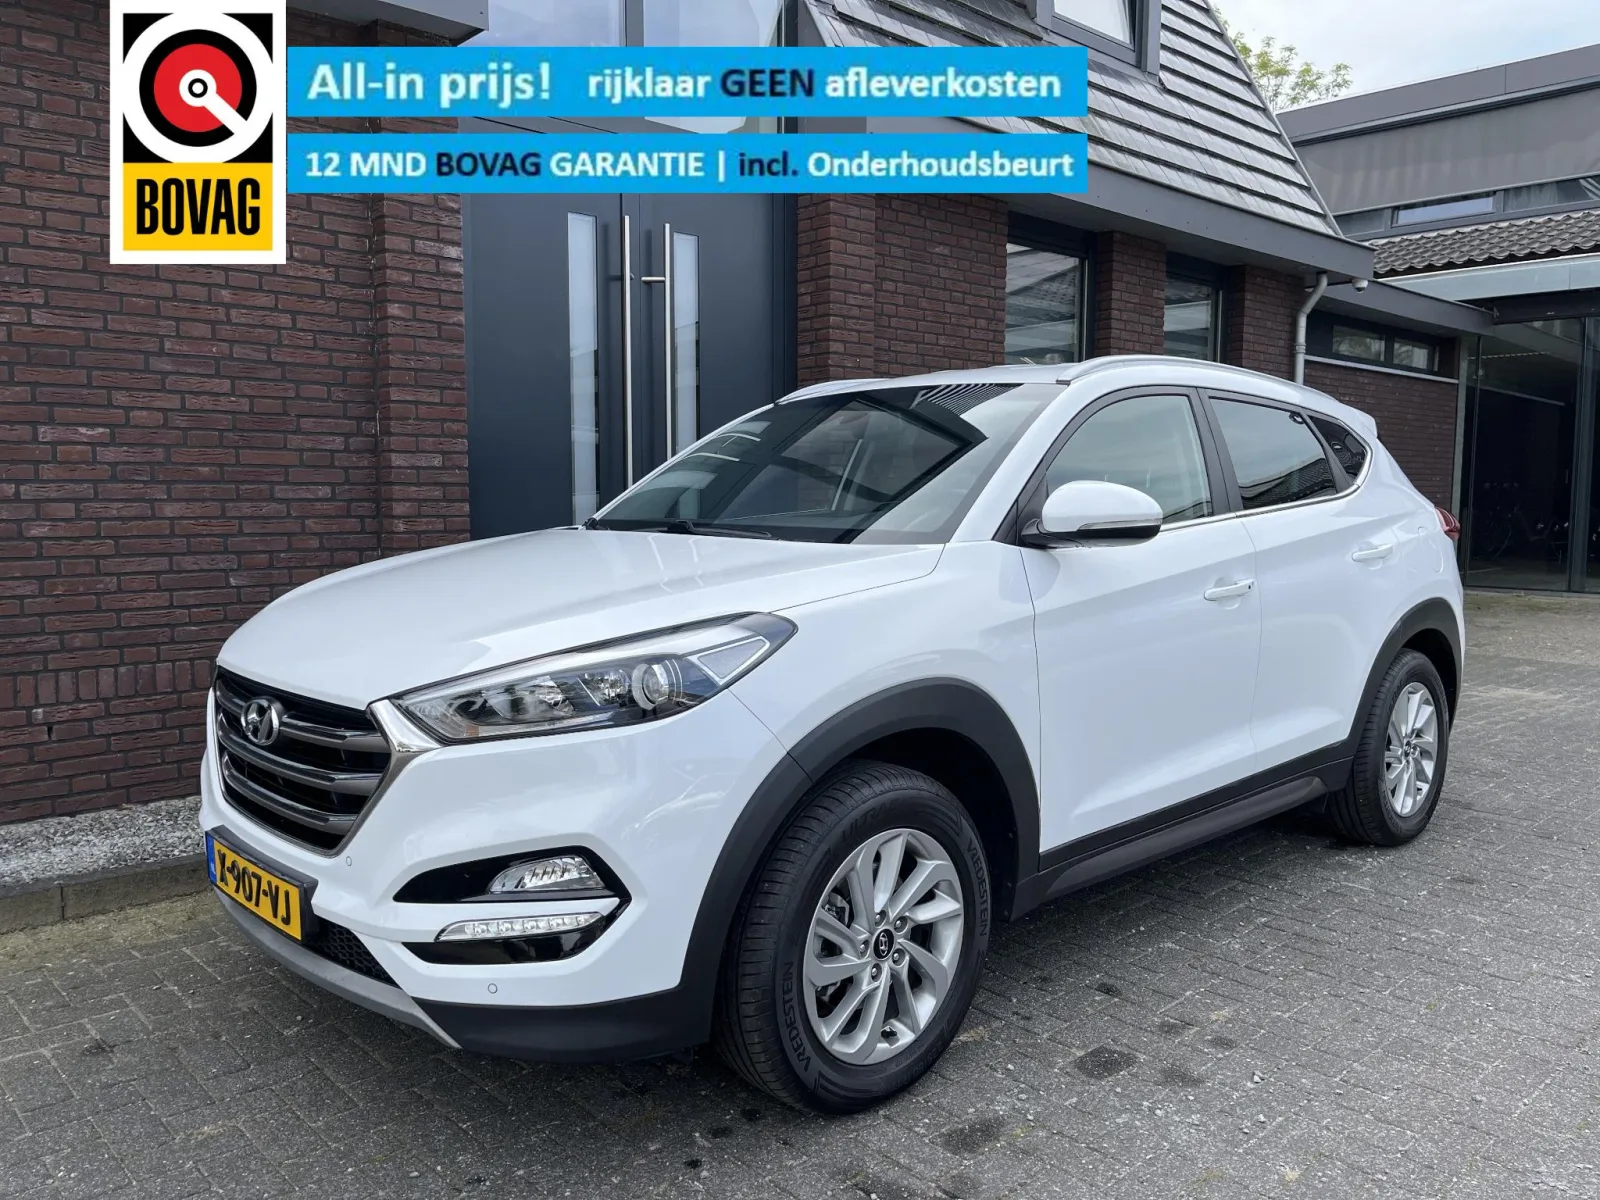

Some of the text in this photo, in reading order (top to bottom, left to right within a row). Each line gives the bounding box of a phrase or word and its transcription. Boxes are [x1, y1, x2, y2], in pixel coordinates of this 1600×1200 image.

[217, 849, 291, 926] X-907-VJ
[967, 837, 988, 937] VREDESTEIN
[783, 961, 812, 1072] VREDESTEIN
